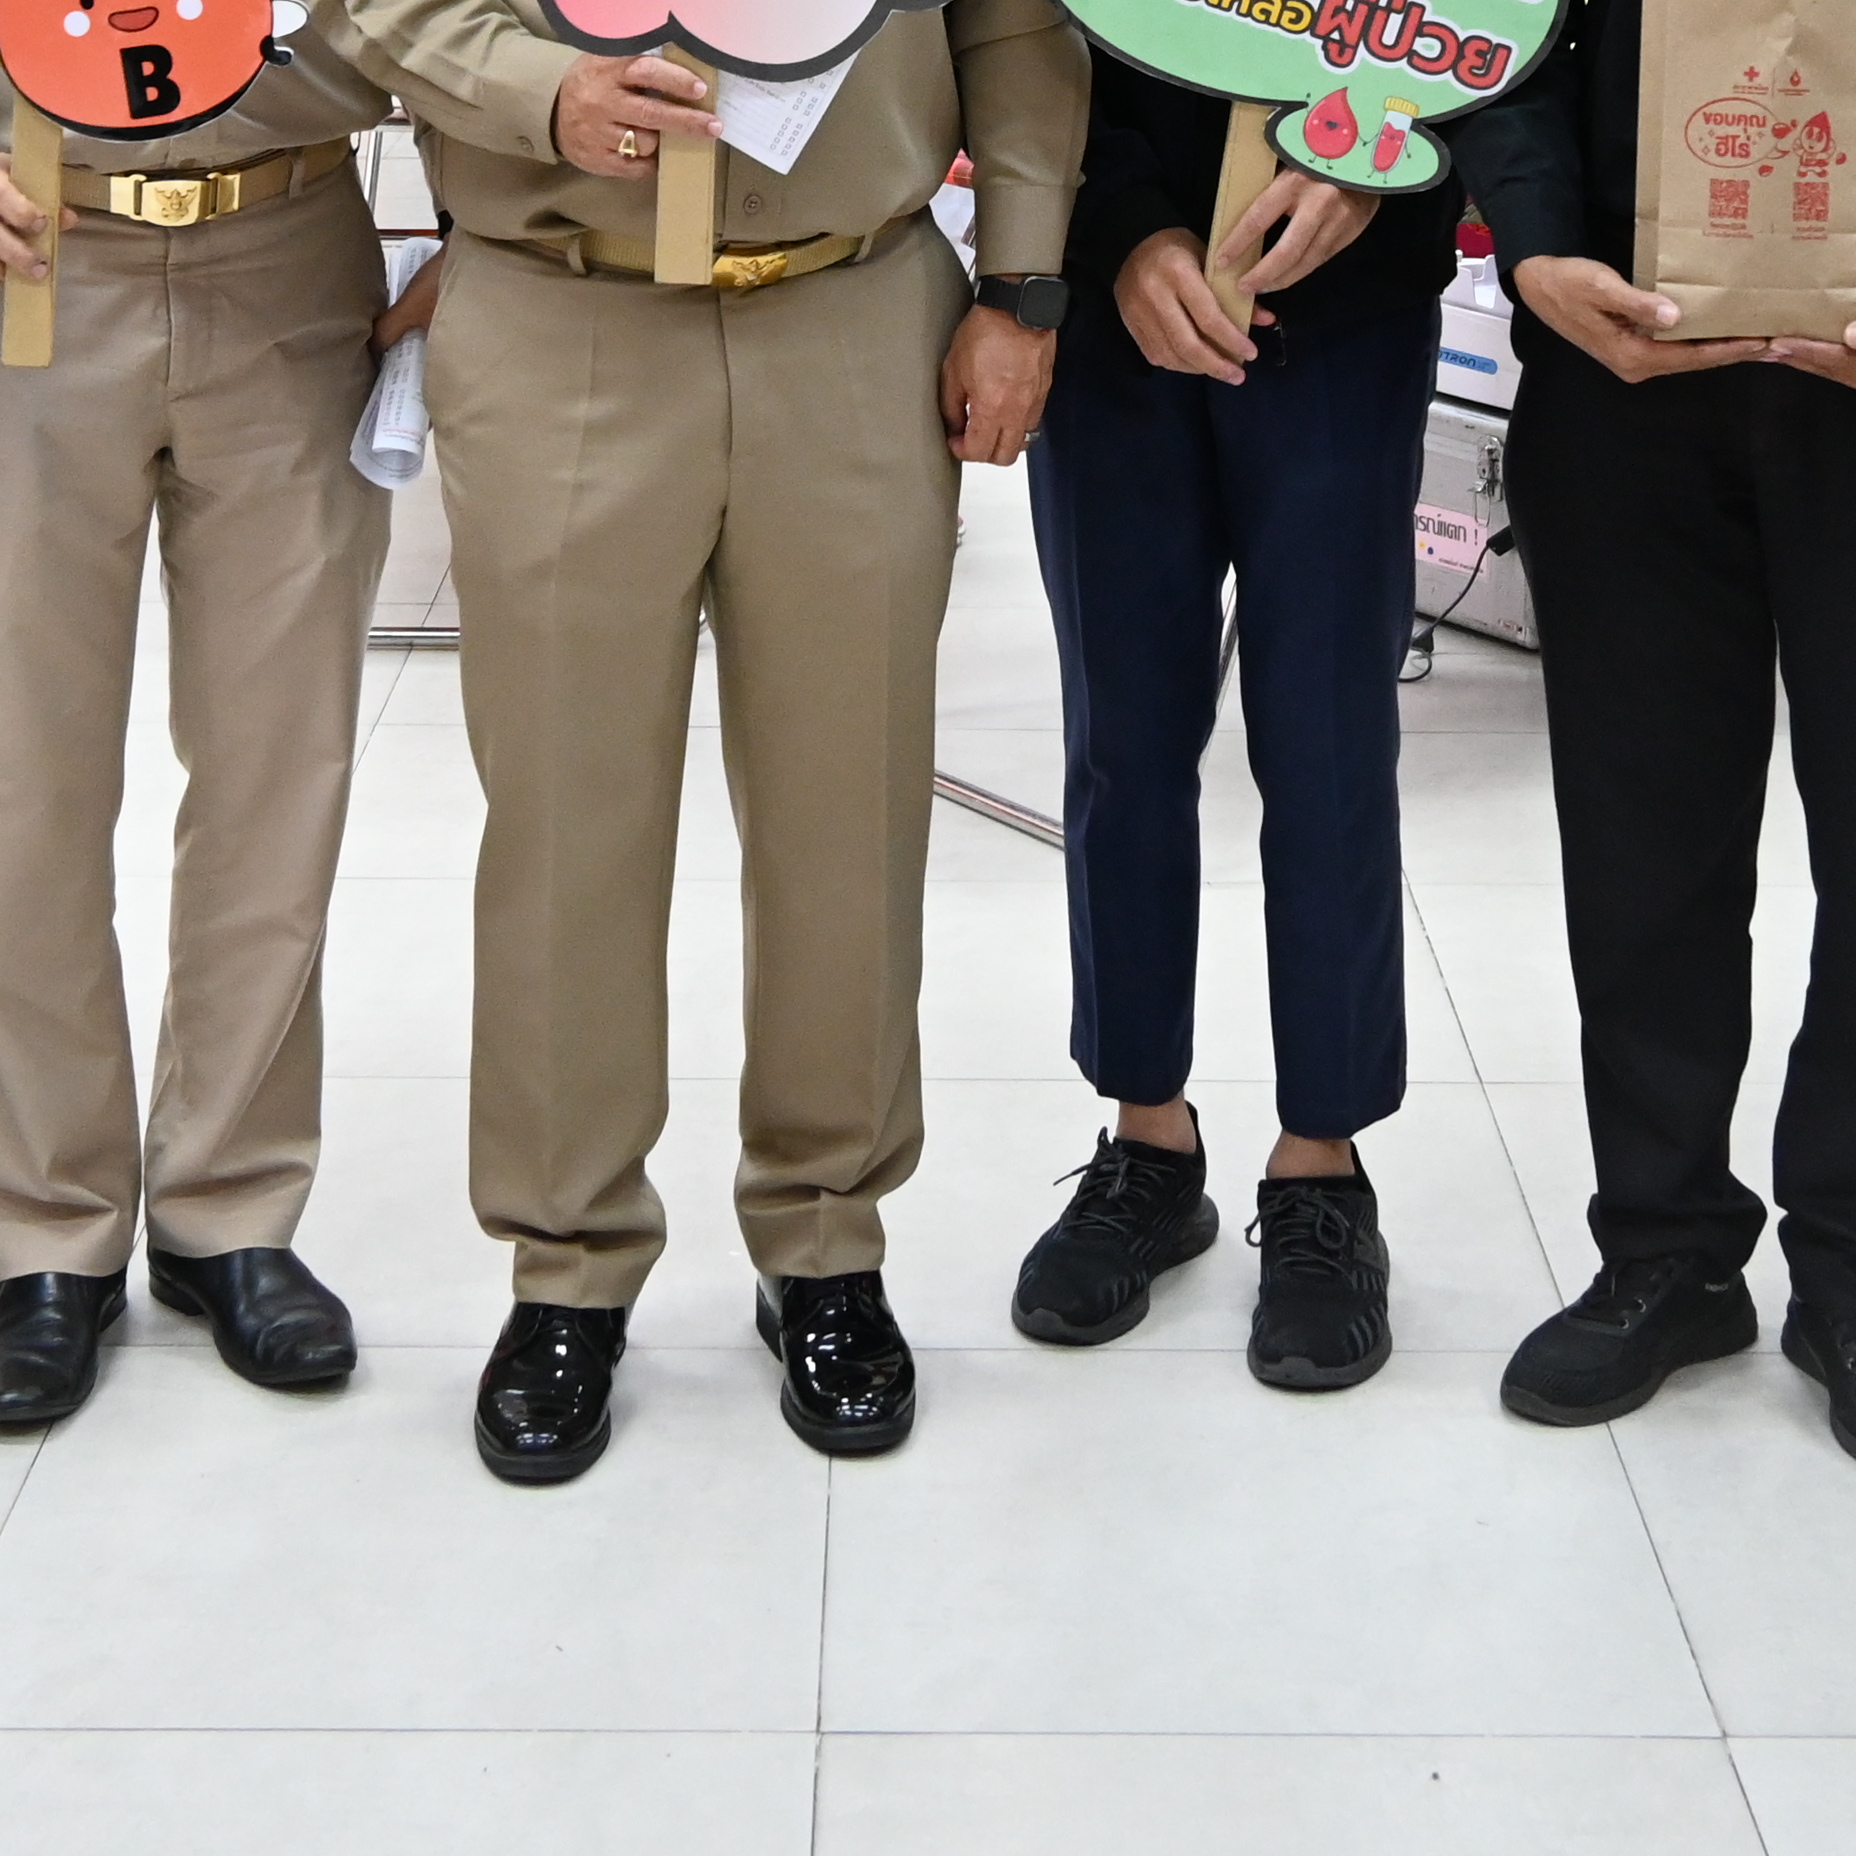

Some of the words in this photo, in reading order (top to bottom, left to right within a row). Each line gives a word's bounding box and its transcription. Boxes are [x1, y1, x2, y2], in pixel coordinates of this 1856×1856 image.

[119, 43, 182, 121] B
[1703, 112, 1767, 134] ขอบคุณ
[1714, 134, 1752, 159] ฮีโร่
